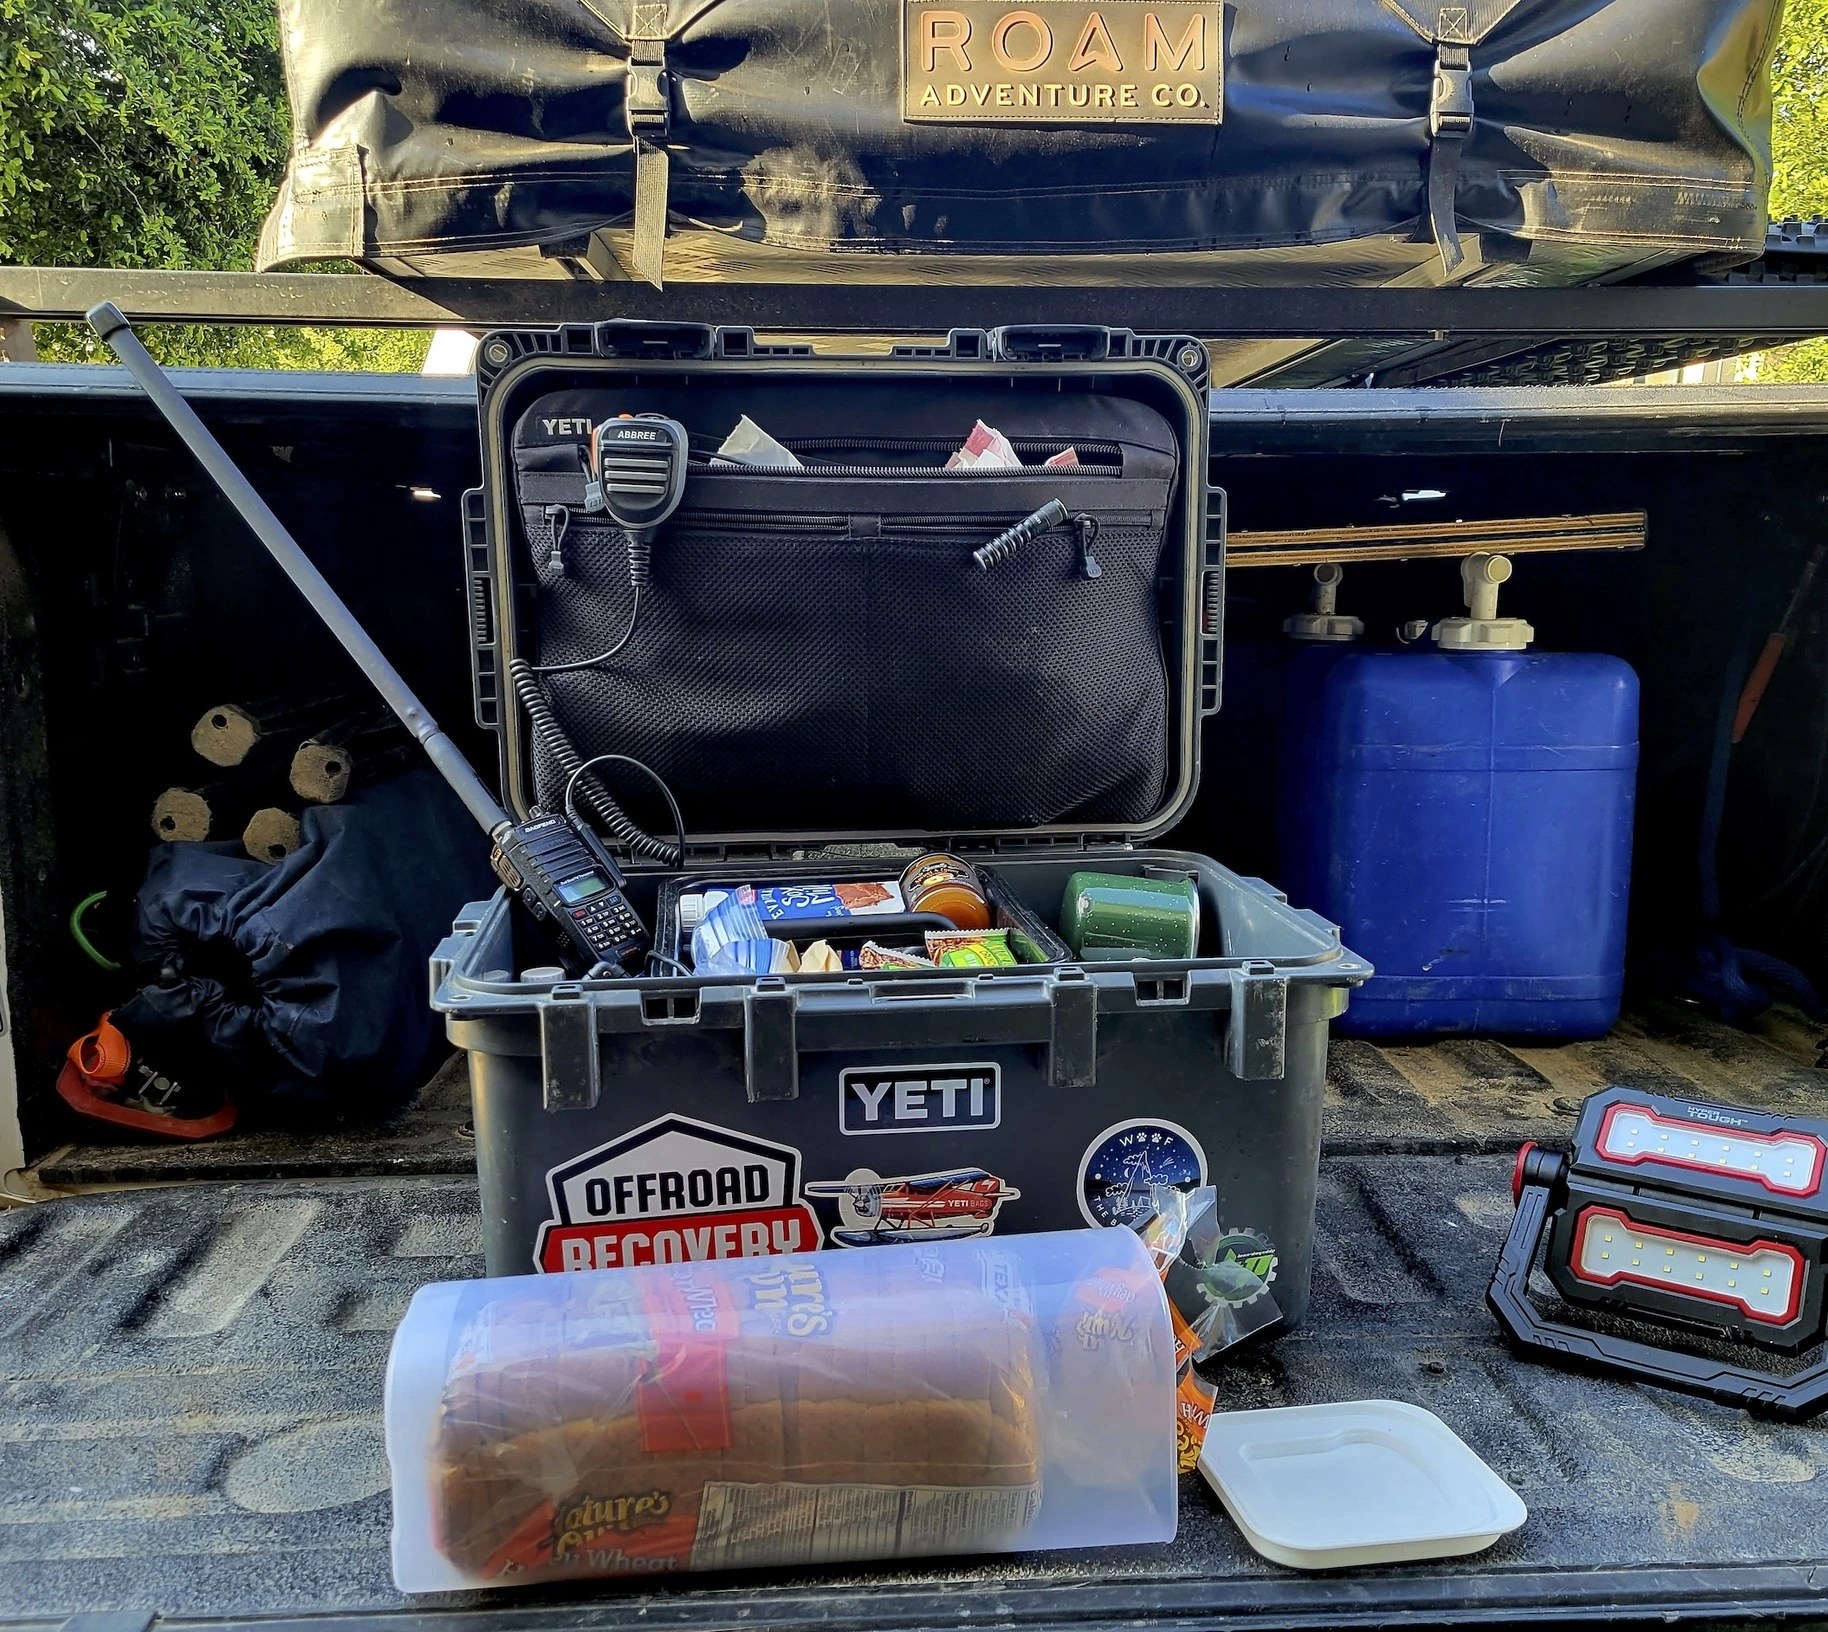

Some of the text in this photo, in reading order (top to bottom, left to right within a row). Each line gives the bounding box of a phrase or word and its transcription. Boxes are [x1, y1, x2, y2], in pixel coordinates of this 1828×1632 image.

[920, 10, 1206, 73] ROAM
[919, 83, 1210, 109] ADVENTURE CO.
[542, 418, 592, 435] YETI
[617, 430, 657, 441] ABBREE
[851, 1078, 984, 1121] YETI
[1687, 1106, 1720, 1116] HYPER
[1688, 1110, 1742, 1126] TOUGH
[585, 1164, 769, 1217] OFFROAD
[947, 1199, 989, 1207] YETI BAGS
[1093, 1195, 1109, 1218] THE
[561, 1220, 802, 1272] RECOVERY
[562, 1490, 670, 1530] ature's
[585, 1548, 677, 1571] Wheat
